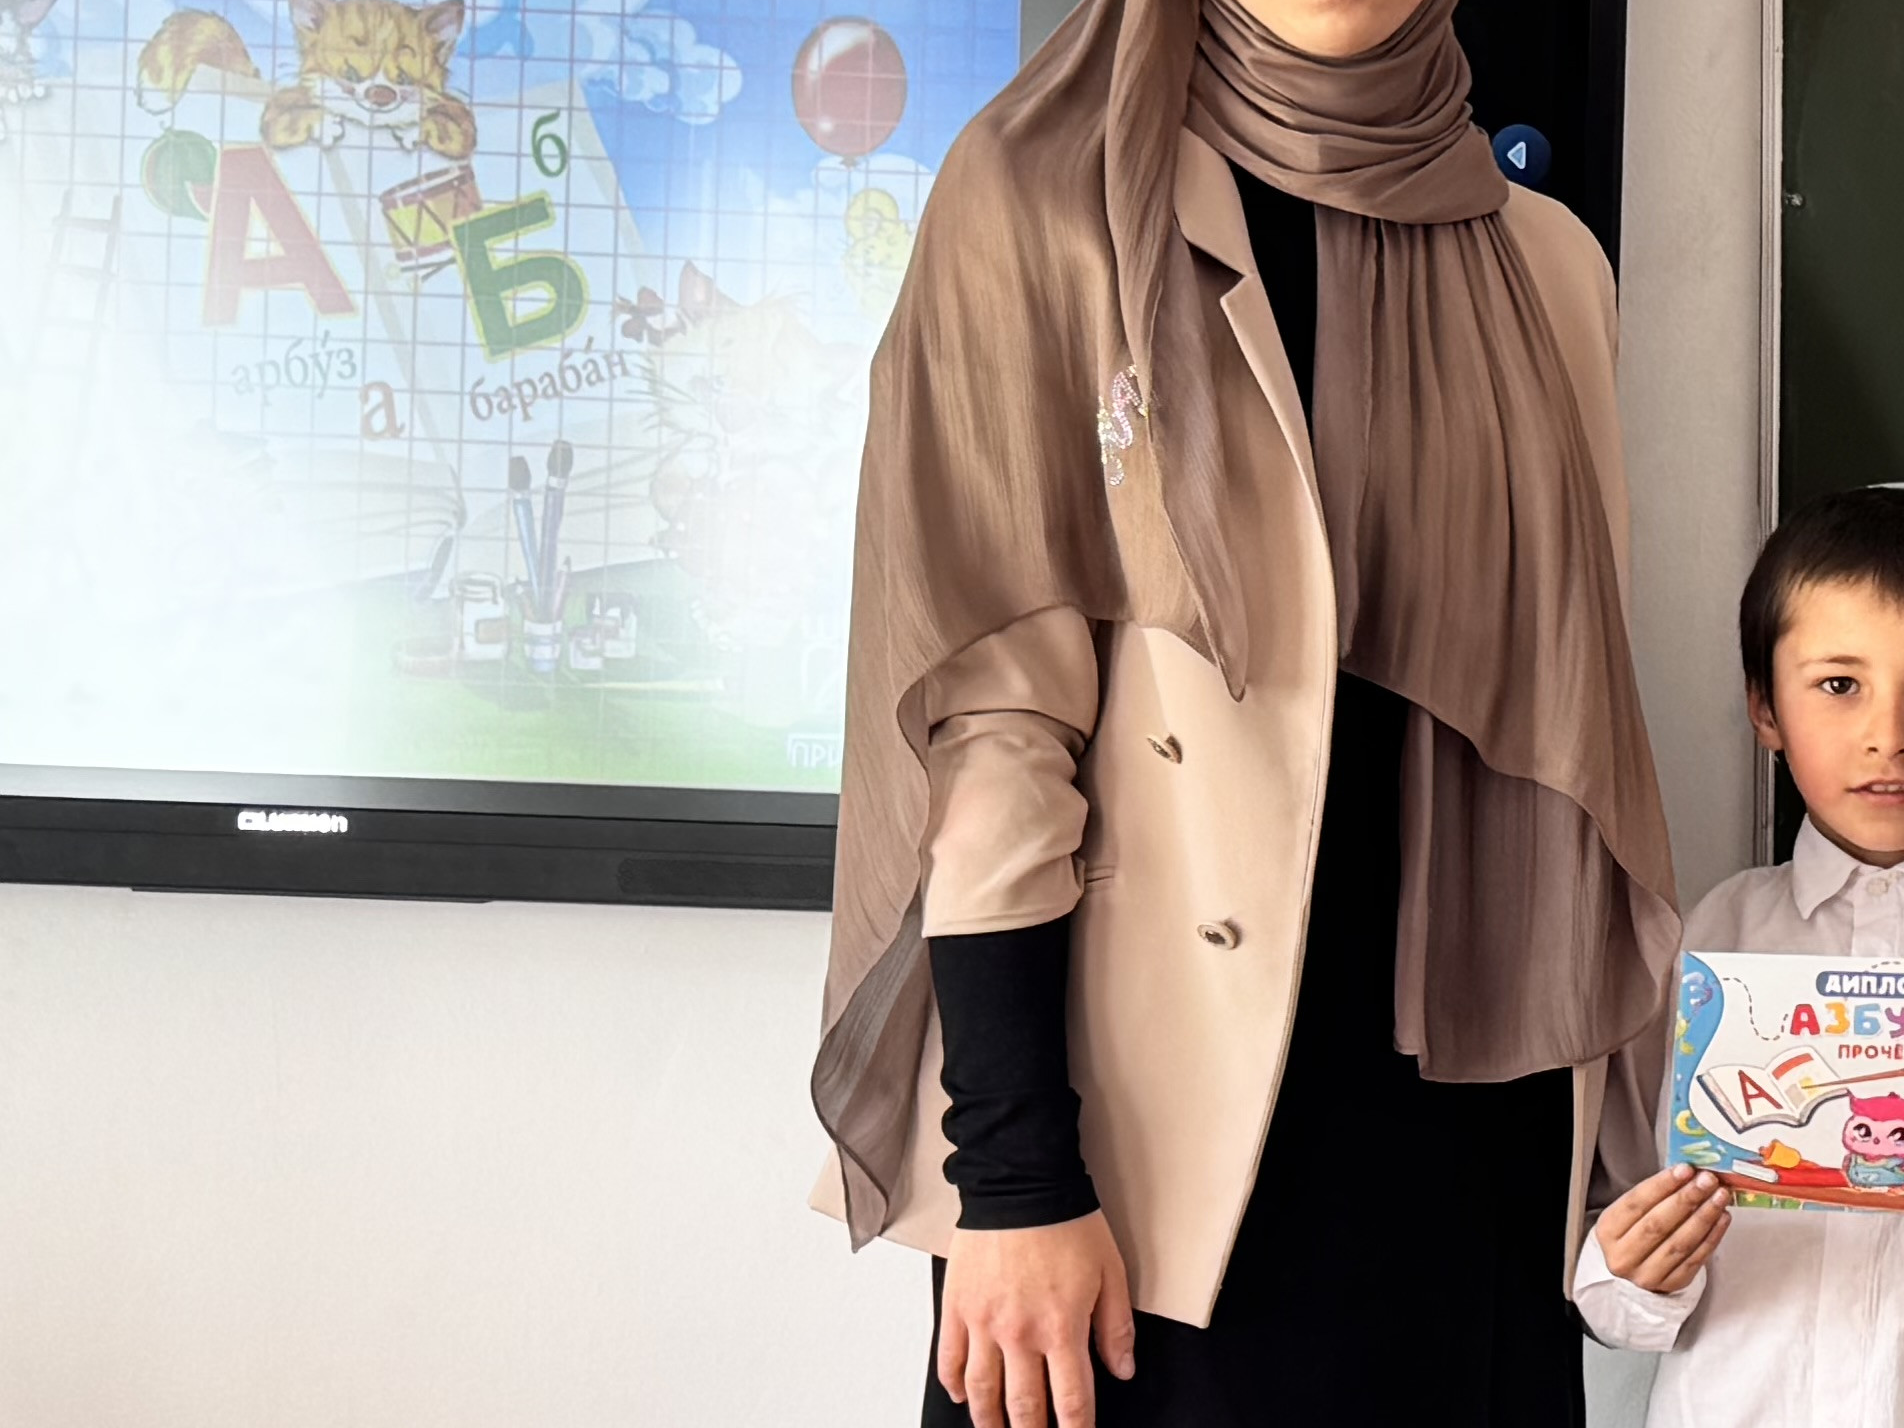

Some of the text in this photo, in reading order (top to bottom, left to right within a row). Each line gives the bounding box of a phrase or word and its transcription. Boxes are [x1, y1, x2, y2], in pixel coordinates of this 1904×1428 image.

[531, 110, 568, 178] б
[203, 144, 356, 326] А
[452, 196, 587, 357] Б
[360, 380, 404, 442] а
